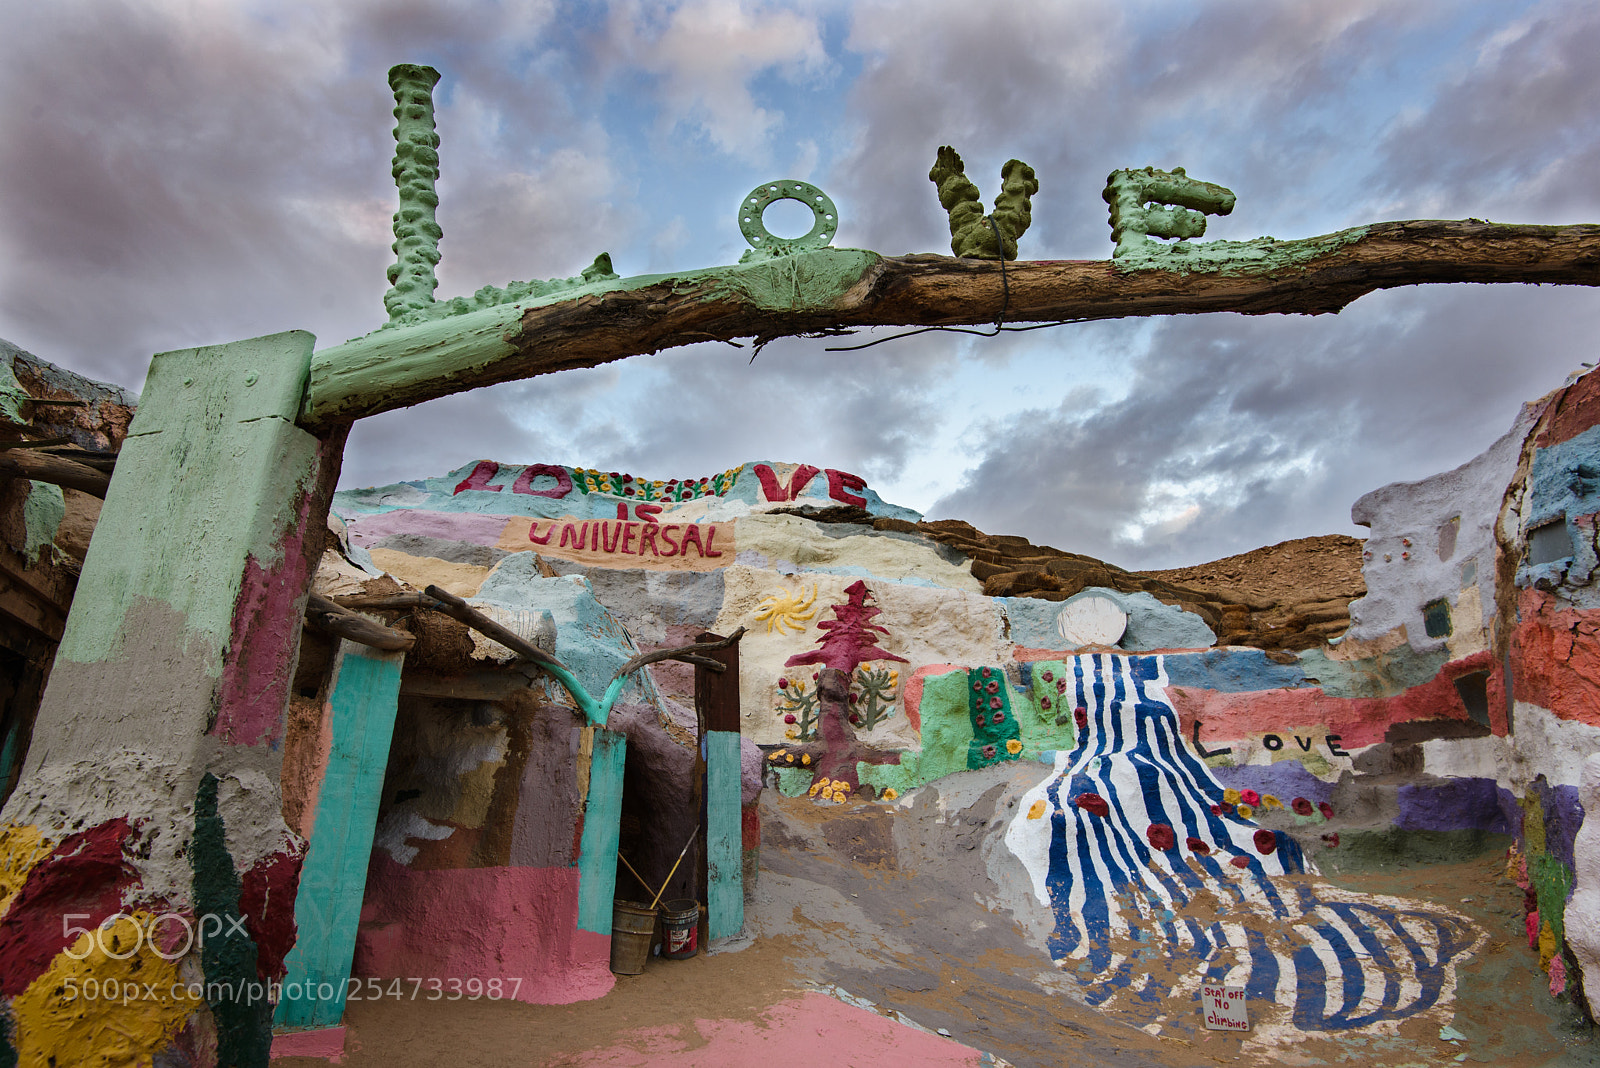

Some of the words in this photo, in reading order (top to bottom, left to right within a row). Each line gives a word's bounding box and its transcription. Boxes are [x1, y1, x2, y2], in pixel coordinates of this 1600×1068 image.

[616, 501, 664, 522] IS
[528, 521, 723, 558] UNIVERSAL
[1192, 719, 1351, 759] LOVE
[1214, 998, 1230, 1010] NO
[1228, 991, 1245, 1000] OFF
